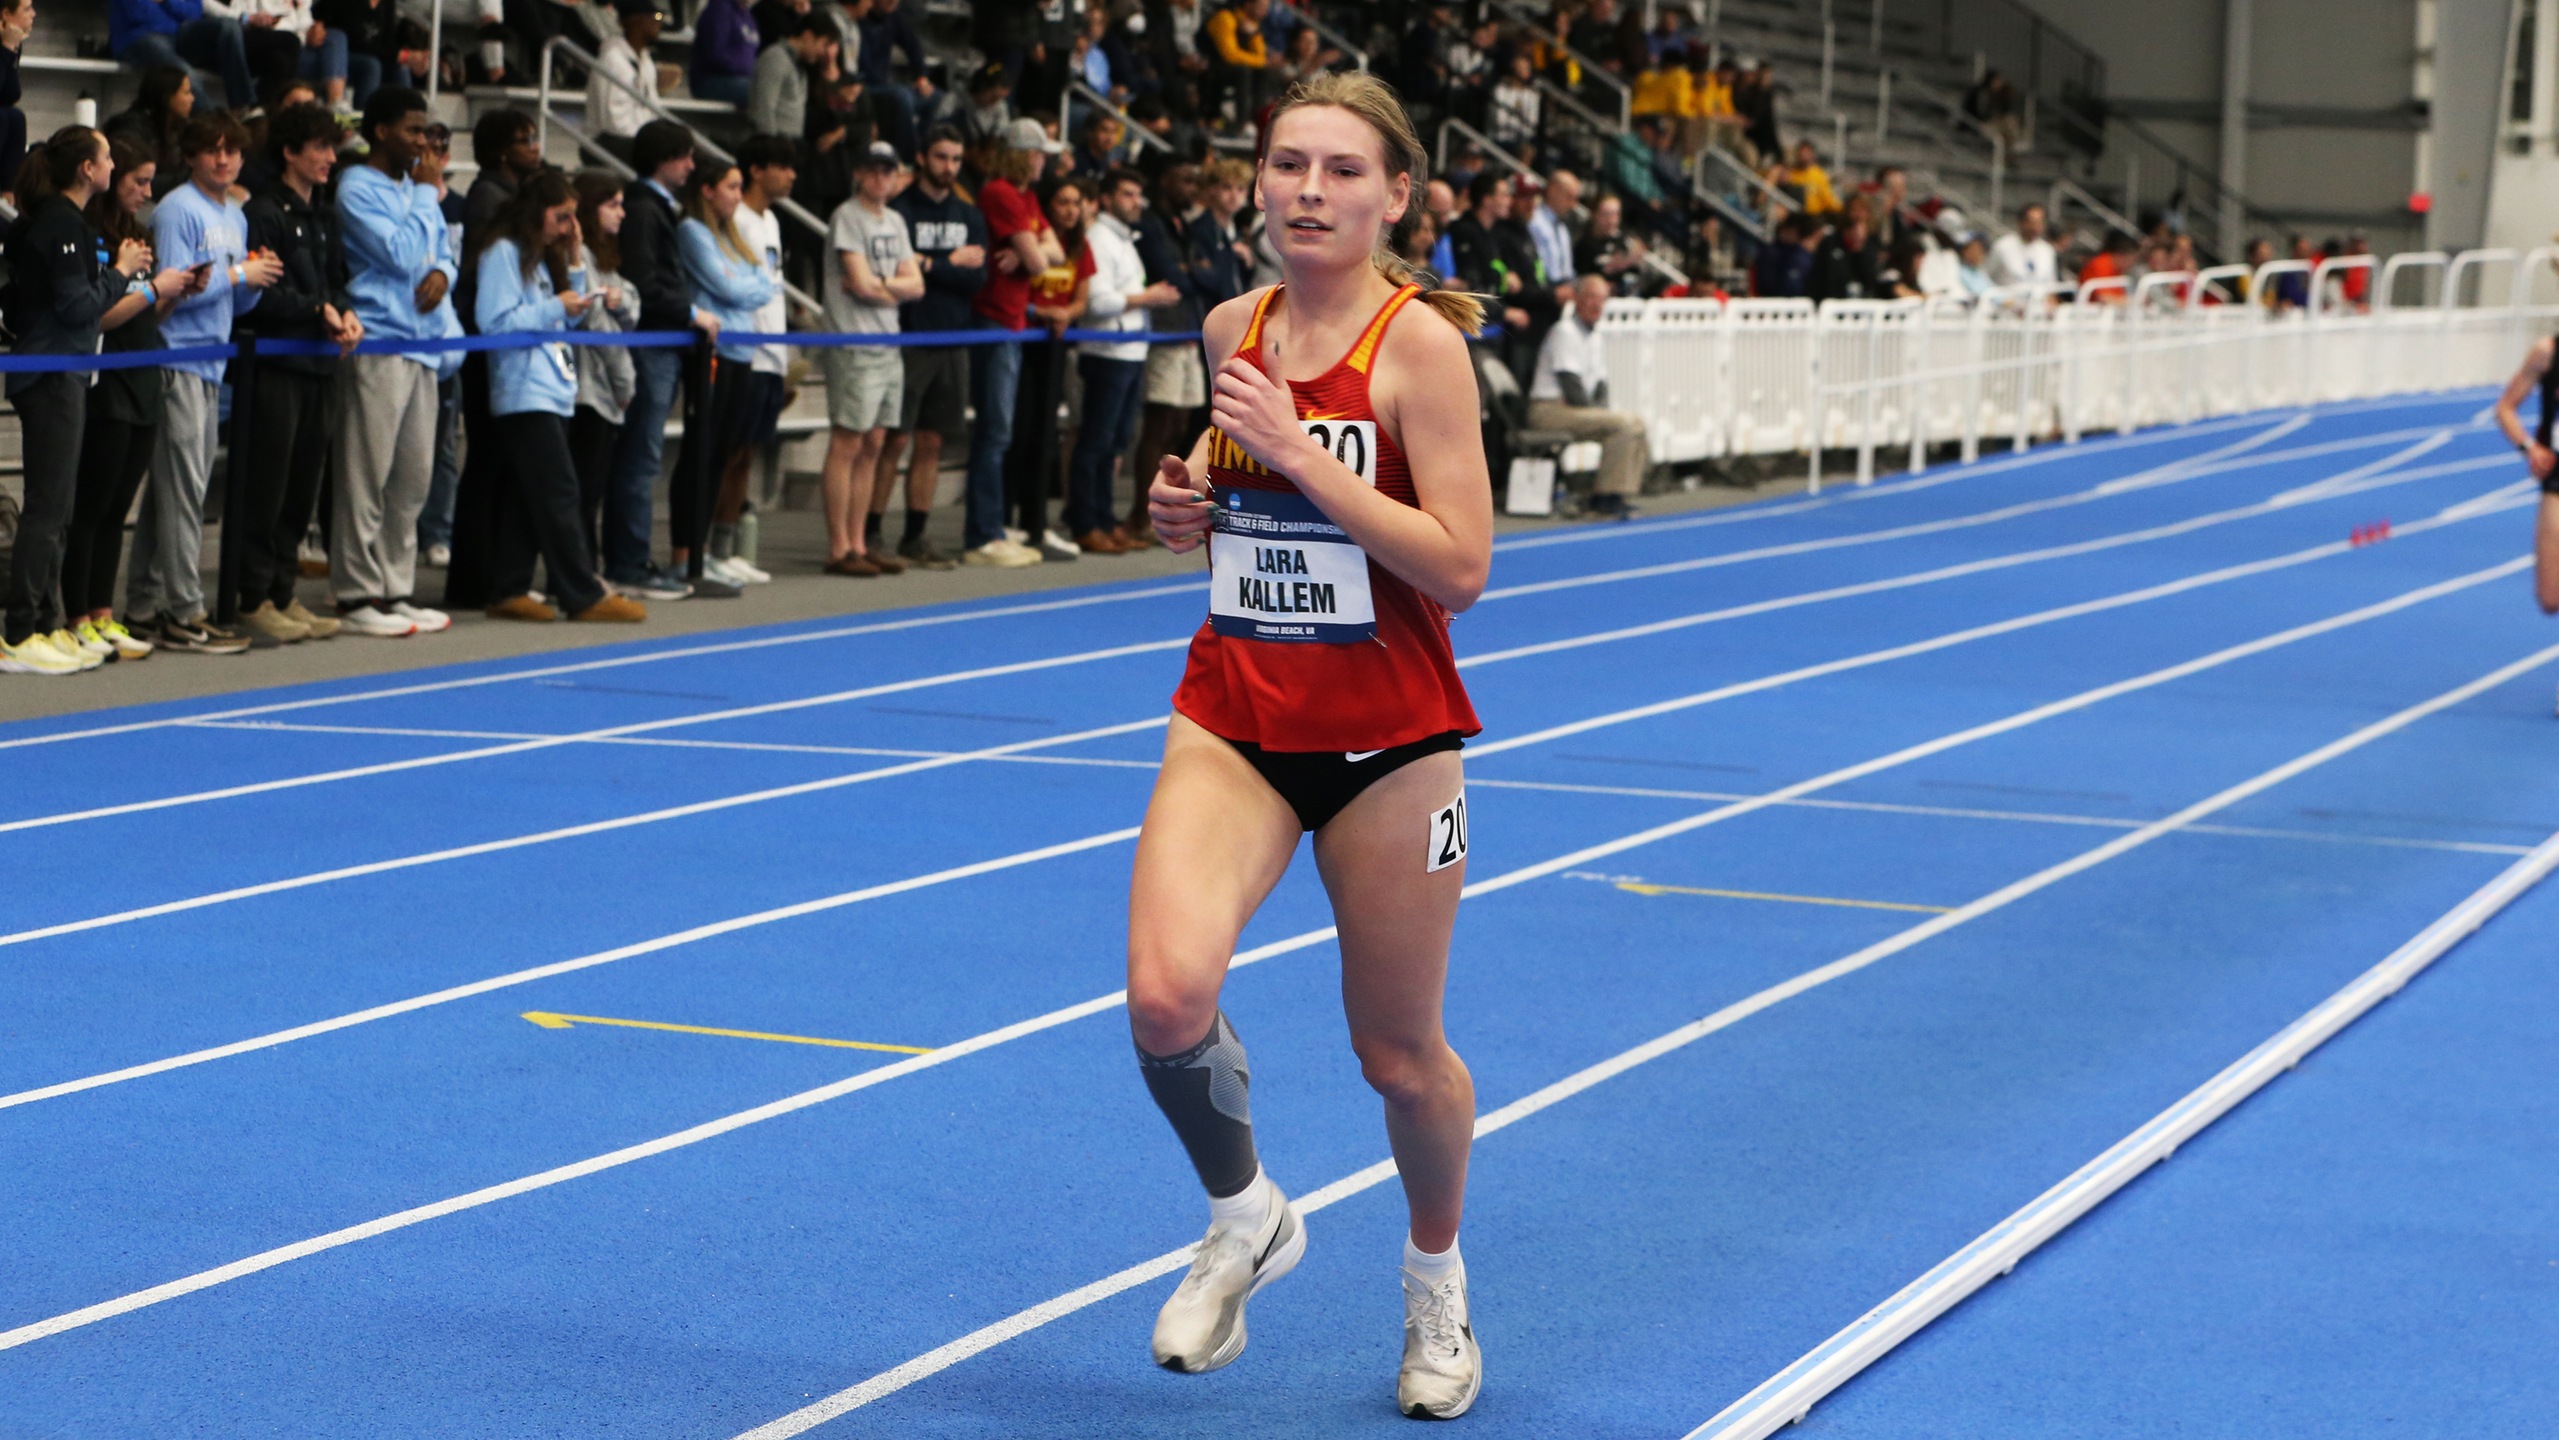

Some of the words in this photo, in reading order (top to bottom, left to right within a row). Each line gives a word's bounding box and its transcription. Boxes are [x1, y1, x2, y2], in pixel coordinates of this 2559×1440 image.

[1208, 425, 1268, 477] SIM
[1229, 516, 1252, 530] TRACK
[1258, 520, 1279, 532] FIELD
[1255, 546, 1308, 574] LARA
[1239, 577, 1336, 614] KALLEM
[1439, 797, 1466, 866] 20
